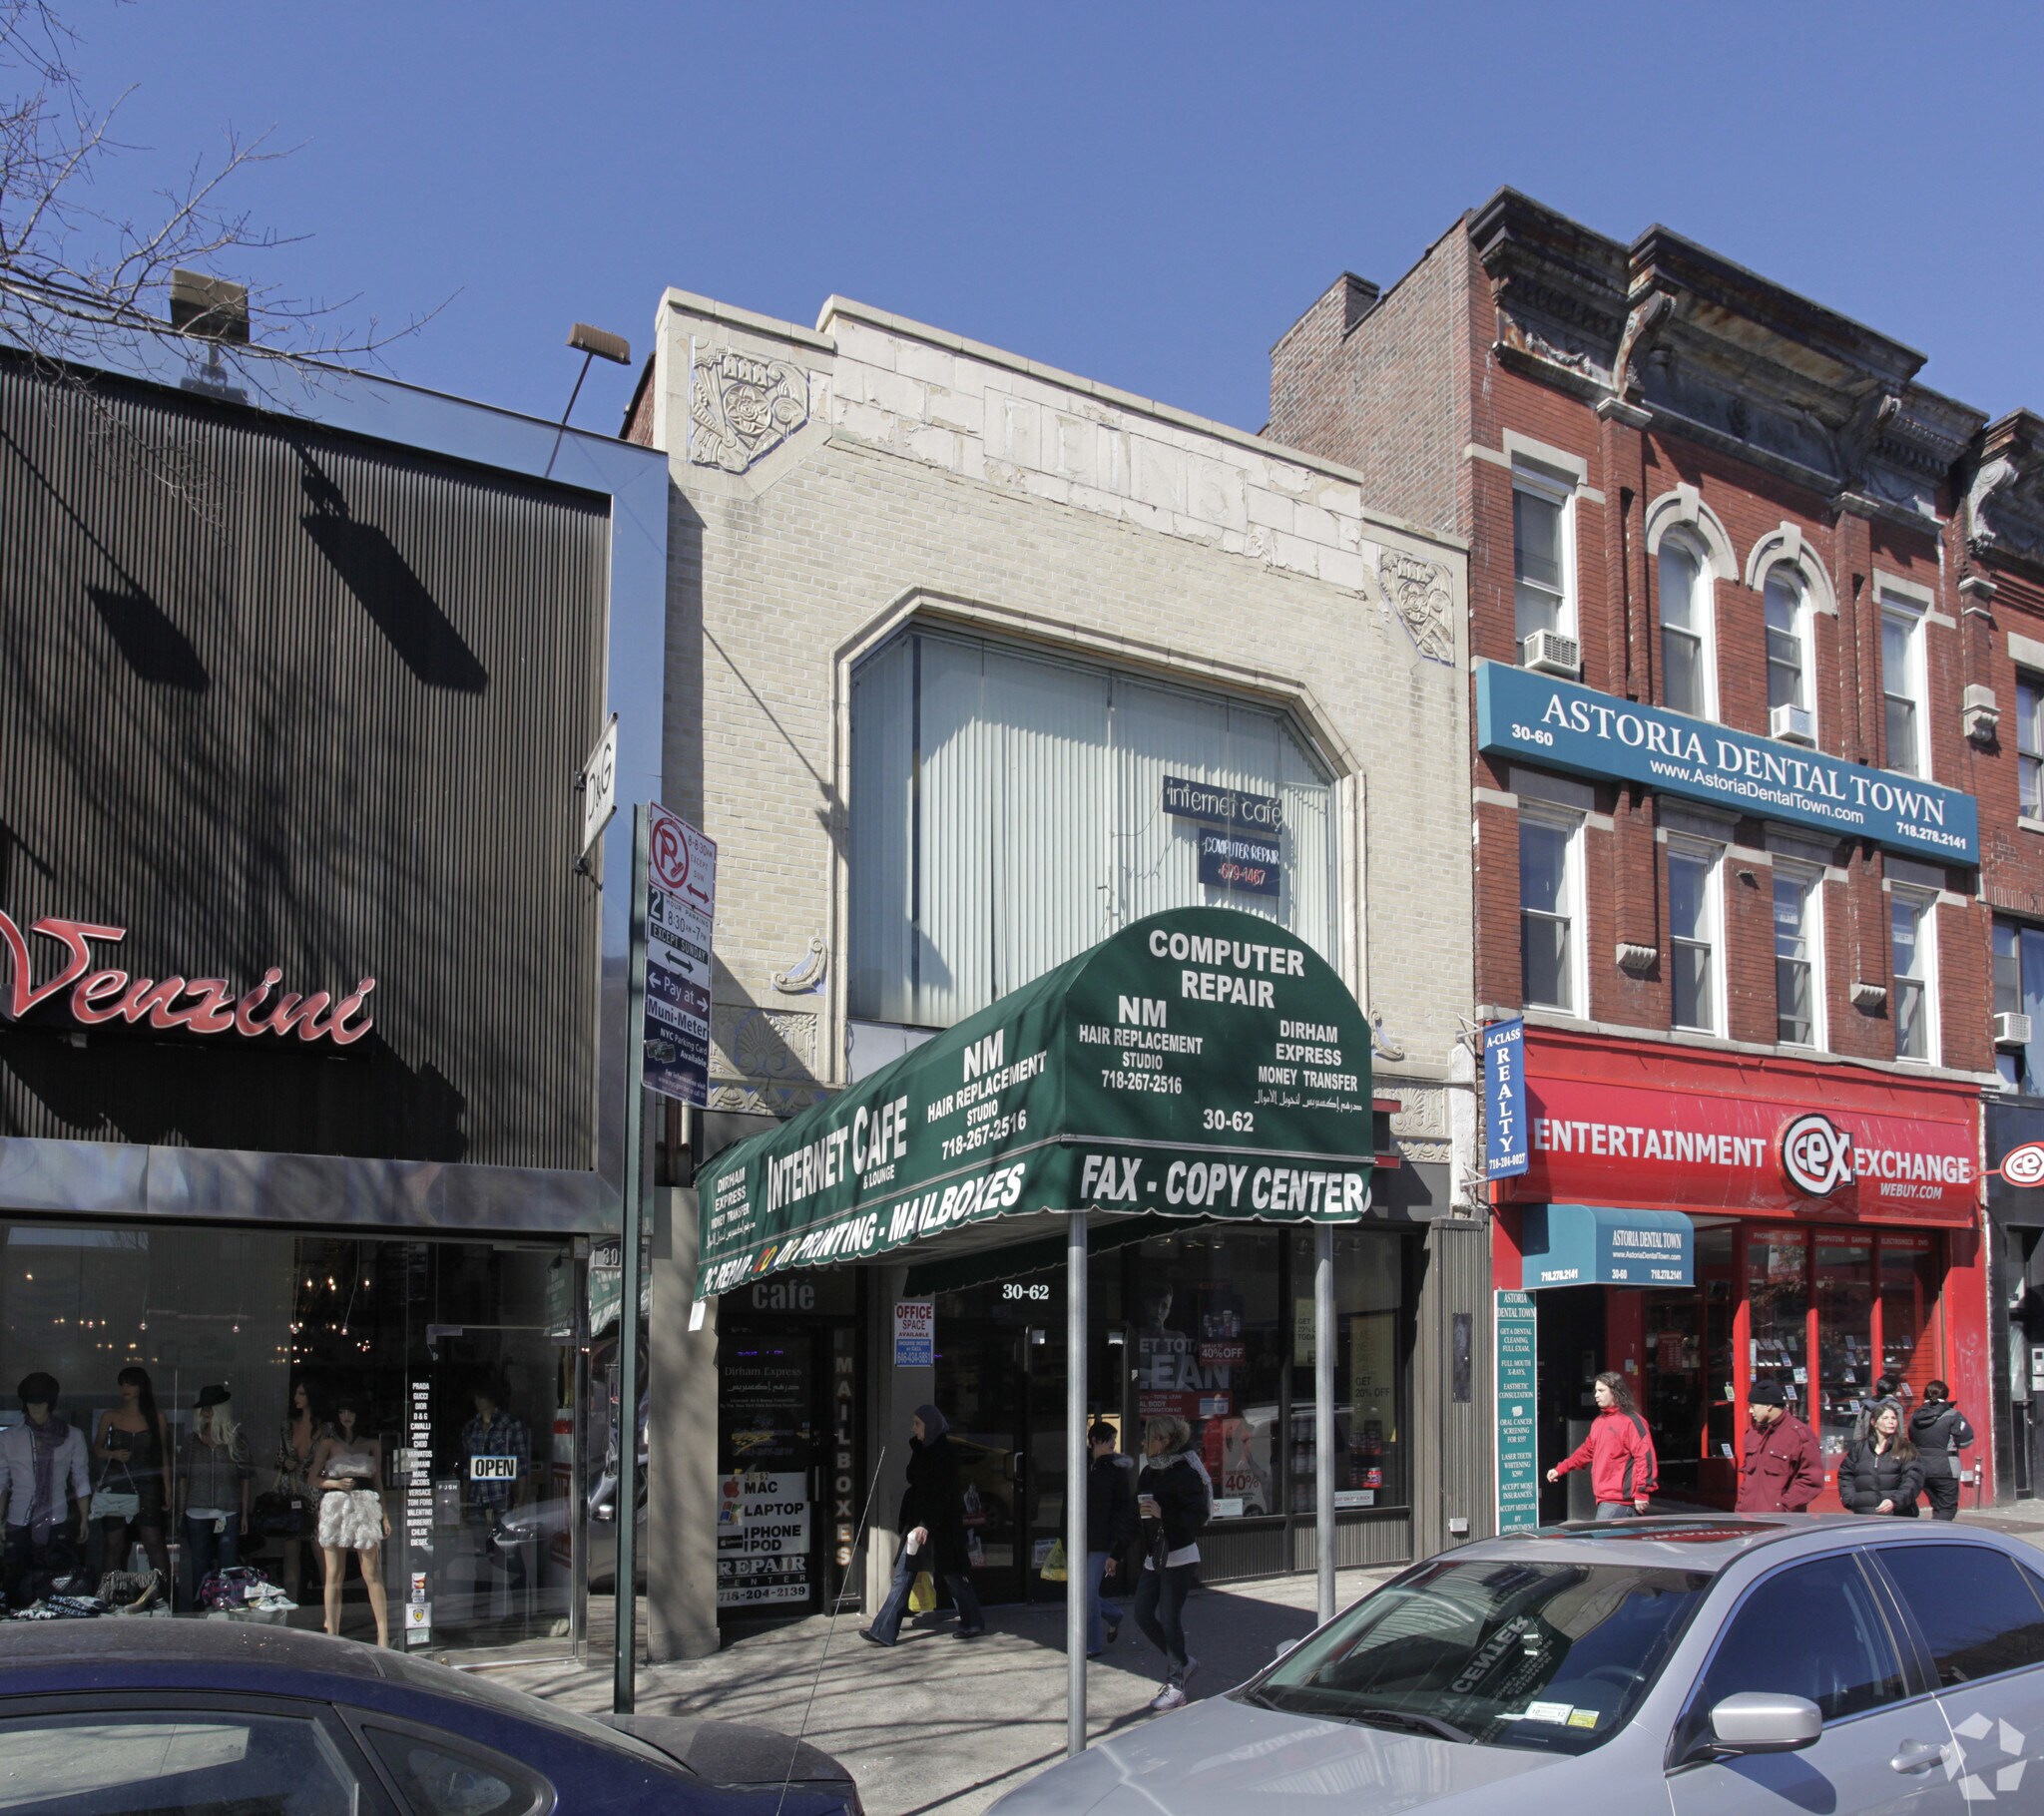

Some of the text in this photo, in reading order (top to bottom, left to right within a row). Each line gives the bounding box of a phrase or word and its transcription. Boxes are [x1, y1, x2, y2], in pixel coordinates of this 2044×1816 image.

[1512, 723, 1554, 746] 30-60
[1541, 694, 1944, 826] ASTORIA DENTAL TOWN
[588, 742, 612, 821] D&G
[1650, 760, 1864, 824] www.AstoriaDentalTown.com
[1169, 779, 1238, 818] internet
[1896, 821, 1966, 850] 718.278.2141
[1204, 836, 1279, 865] COMPUTER REPAIR
[651, 888, 662, 920] 2
[666, 898, 709, 928] HOUR PARKING
[653, 926, 706, 962] EXCEPT SUNDAY
[1149, 929, 1304, 977] COMPUTER
[0, 908, 375, 1046] Venzini
[664, 976, 695, 1005] Pay at
[1182, 970, 1276, 1009] REPAIR
[649, 998, 708, 1038] Muni-Meter
[1118, 995, 1167, 1029] NM
[660, 1028, 708, 1056] NYC Parking Card
[1079, 1024, 1203, 1055] HAIR REPLACEMENT
[1279, 1020, 1338, 1044] DIRHAM
[1486, 1028, 1521, 1048] A-CLASS
[680, 1050, 707, 1068] Available
[963, 1029, 1004, 1083] NM
[1122, 1052, 1163, 1071] STUDIO
[1276, 1043, 1342, 1067] EXPRESS
[927, 1050, 1047, 1124] HAIR REPLACEMENT
[1101, 1070, 1183, 1095] 718-267-2516
[1259, 1066, 1358, 1092] MONEY TRANSFER
[1496, 1047, 1513, 1152] REALTY
[966, 1099, 998, 1127] STUDIO
[1203, 1109, 1255, 1133] 30-62
[942, 1109, 1027, 1160] 718-267-2516
[1534, 1118, 1767, 1168] ENTERTAINMENT
[766, 1095, 907, 1212] INTERNET CAFE
[862, 1163, 895, 1190] & LOUNGE
[1854, 1148, 1970, 1184] EXCHANGE
[718, 1166, 746, 1193] DIRHAM
[1080, 1154, 1366, 1213] FAX COPY CENTER
[1879, 1182, 1942, 1200] WEBUY.COM
[715, 1185, 747, 1212] EXPRESS
[711, 1202, 750, 1229] MONEY TRANSFER
[701, 1265, 718, 1295] PC
[714, 1254, 753, 1290] REPAIR
[791, 1212, 877, 1260] PRINTING
[887, 1162, 1026, 1242] MAILBOXES
[1612, 1229, 1682, 1248] ASTORIA DENTAL TOWN
[1612, 1250, 1682, 1261] www.AstoriaDentalTown.com
[1541, 1268, 1578, 1282] 718.278.2141
[1612, 1269, 1627, 1280] 30-60
[1651, 1269, 1682, 1280] 718.278.2141
[752, 1278, 814, 1310] café
[1002, 1283, 1050, 1300] 30-62
[1504, 1292, 1527, 1304] ASTORIA
[896, 1305, 932, 1319] OFFICE
[1498, 1308, 1535, 1318] DENTAL TOWN
[902, 1319, 926, 1330] SPACE
[1202, 1348, 1244, 1358] 40% OFF
[725, 1367, 801, 1378] Dirham Express
[1355, 1377, 1371, 1386] GET
[1374, 1388, 1390, 1397] OFF
[474, 1458, 515, 1477] OPEN
[834, 1357, 853, 1567] MAILBOXES
[408, 1488, 432, 1497] VERSACE
[410, 1478, 430, 1487] JACOBS
[744, 1481, 777, 1494] MAC
[1226, 1475, 1260, 1491] 40%
[407, 1508, 433, 1517] VALENTINO
[745, 1502, 804, 1517] LAPTOP
[406, 1518, 433, 1527] BURBERRY
[410, 1528, 428, 1537] CHLOE
[1502, 1523, 1534, 1533] APPOINTMENT
[718, 1556, 806, 1576] REPAIR
[718, 1575, 806, 1588] CENTER
[719, 1586, 806, 1601] 718-204-2139
